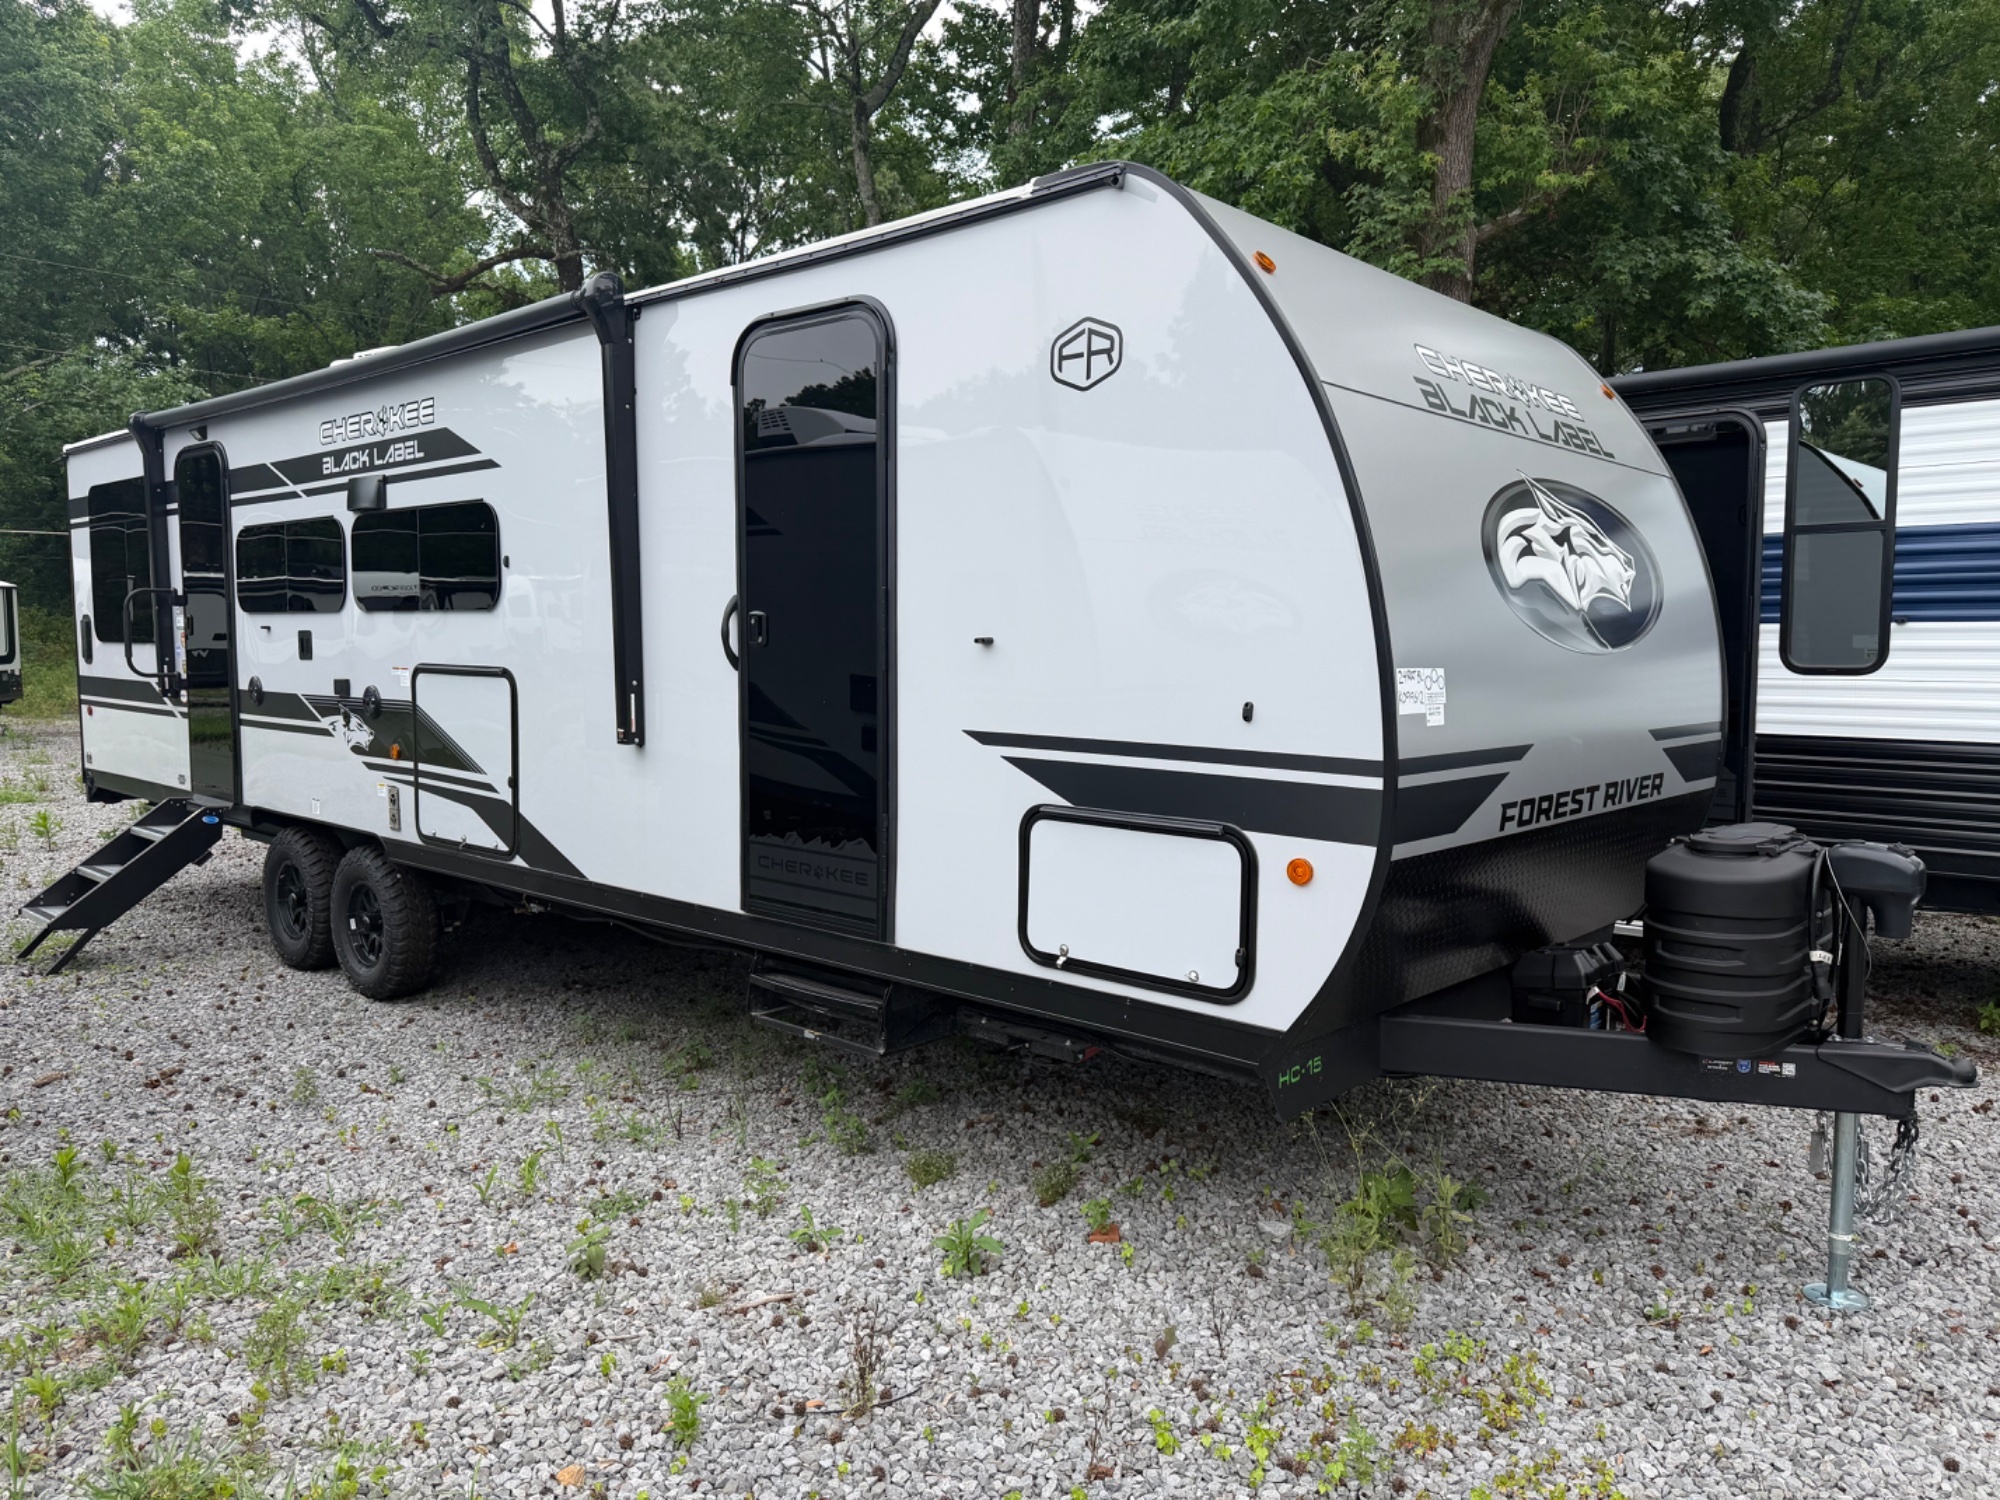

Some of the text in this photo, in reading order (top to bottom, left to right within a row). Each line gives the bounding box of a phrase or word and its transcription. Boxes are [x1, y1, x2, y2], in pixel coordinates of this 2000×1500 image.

[1413, 343, 1585, 422] CHEROKEE
[319, 397, 435, 445] CHEROKEE
[1413, 376, 1616, 459] BLACK LABEL
[322, 440, 425, 475] BLACK LABEL
[1499, 772, 1664, 832] FOREST RIVER
[758, 855, 868, 886] CHEROKEE
